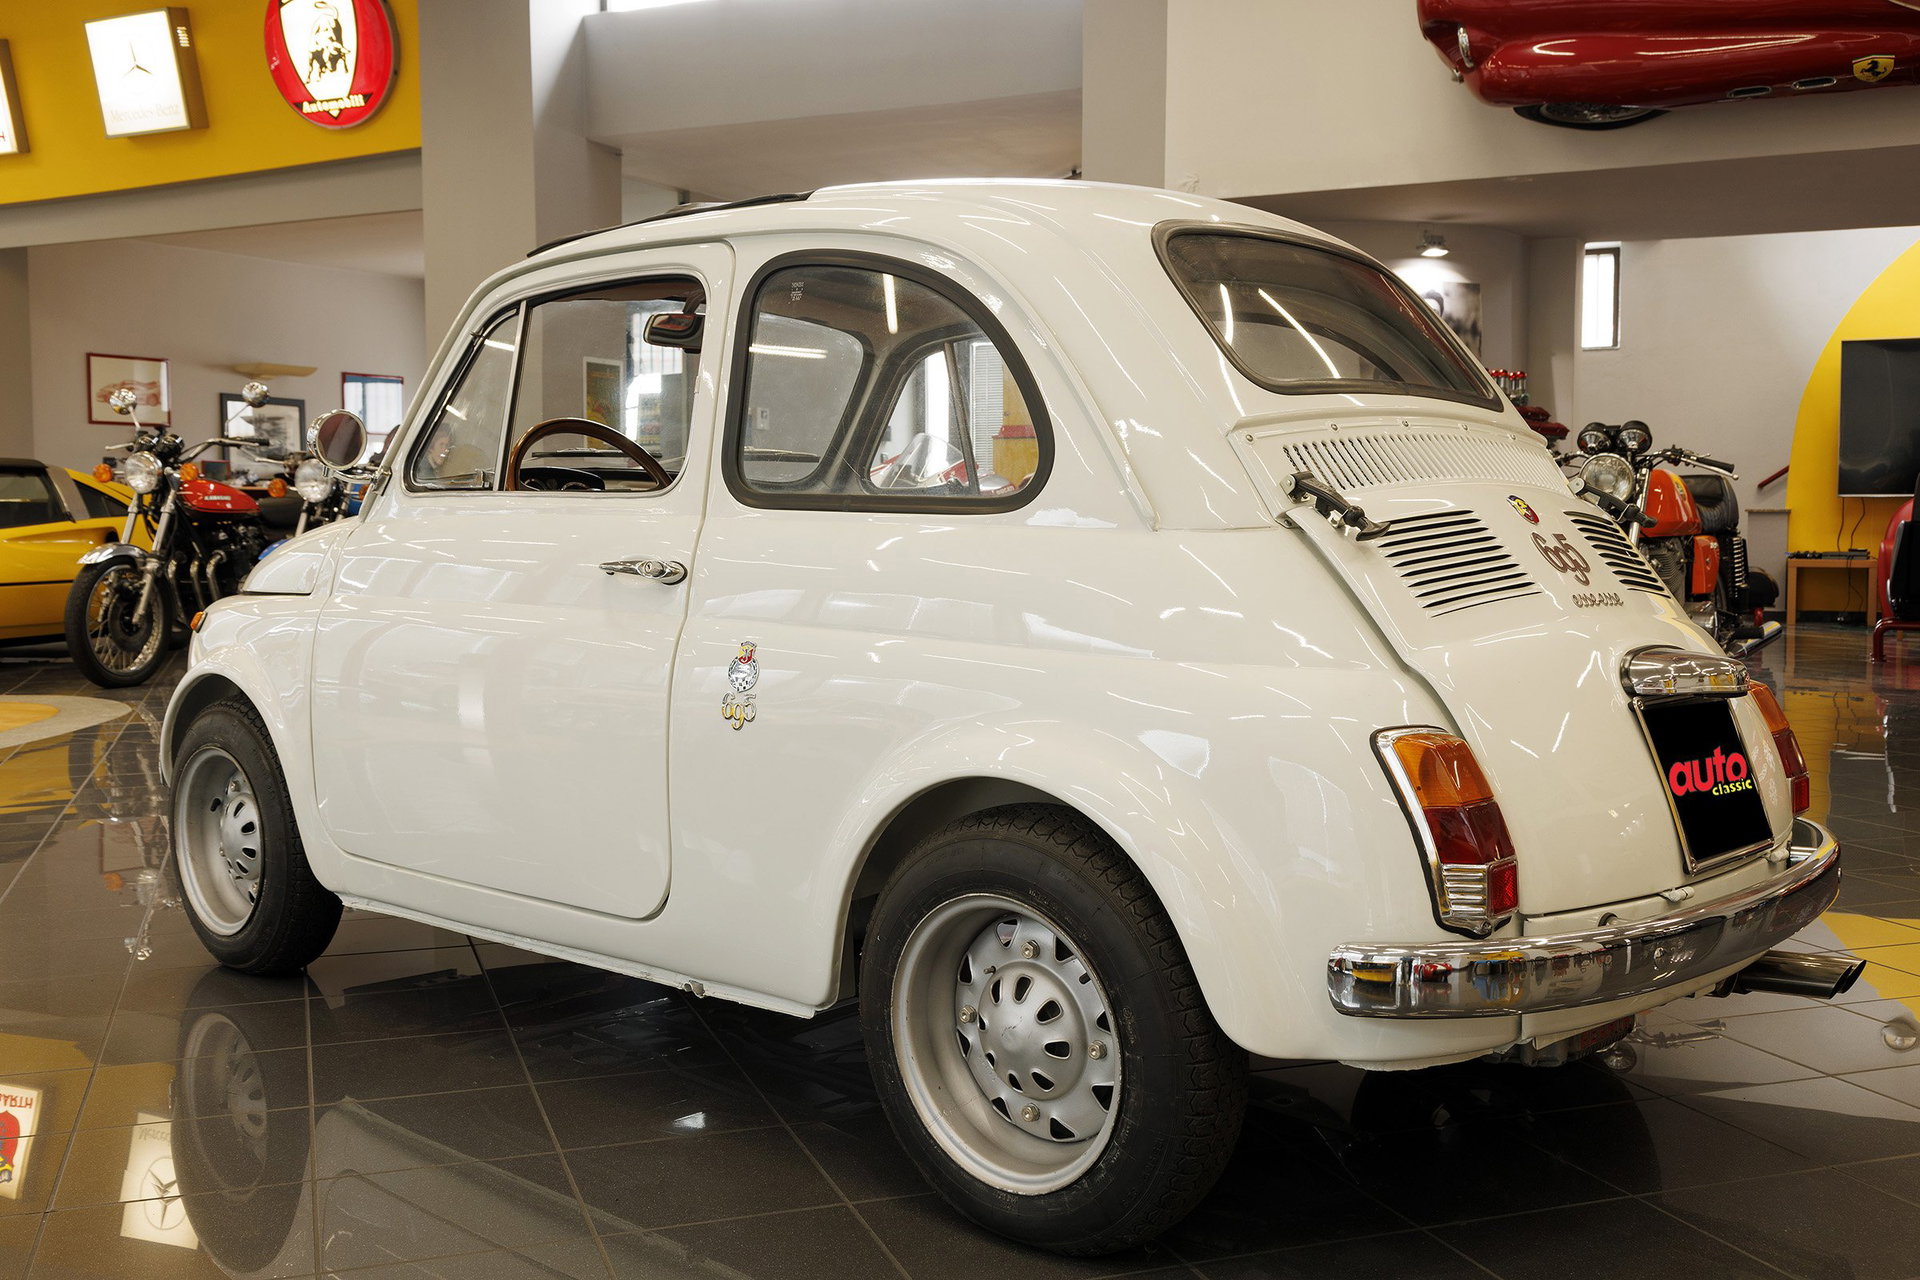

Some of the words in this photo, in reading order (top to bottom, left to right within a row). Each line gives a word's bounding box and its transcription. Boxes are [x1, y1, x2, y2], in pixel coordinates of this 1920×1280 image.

[302, 94, 365, 113] Automobili
[1531, 532, 1591, 586] 695
[721, 691, 757, 731] 695
